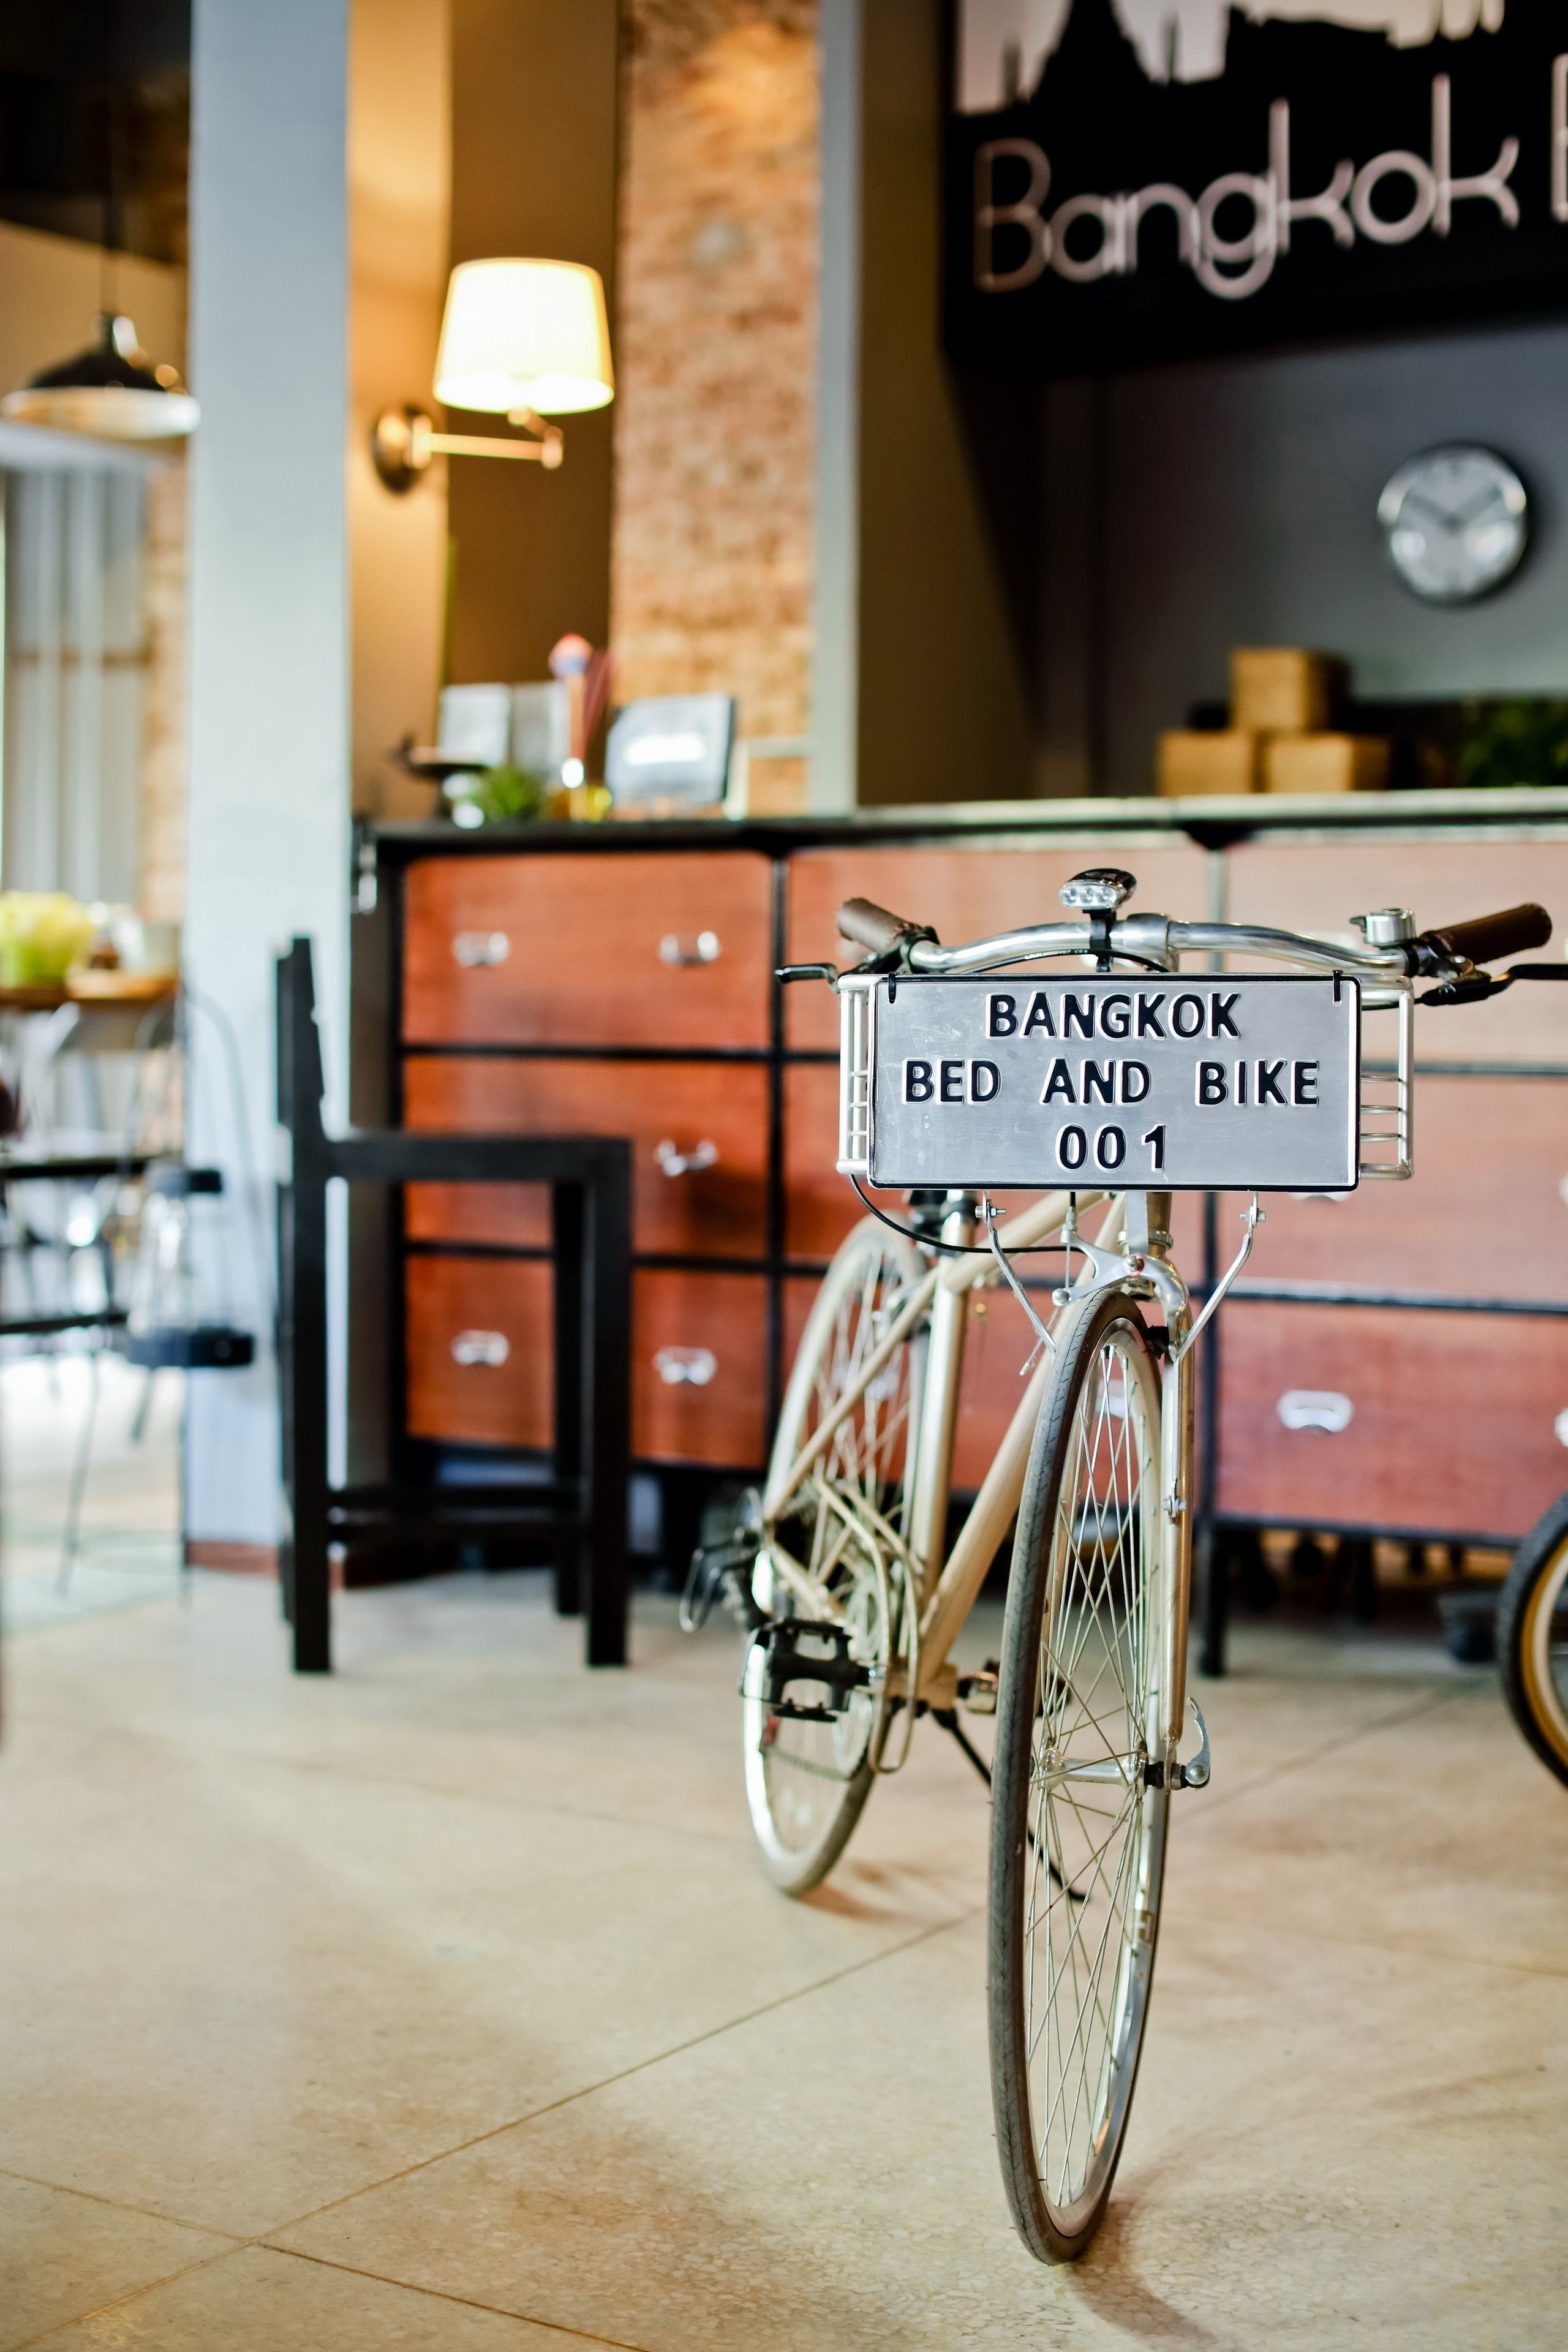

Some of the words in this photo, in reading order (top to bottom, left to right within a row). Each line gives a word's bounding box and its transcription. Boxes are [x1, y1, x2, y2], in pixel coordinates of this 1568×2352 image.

[974, 74, 1520, 299] Bangkok
[988, 992, 1241, 1039] BANGKOK
[903, 1060, 1001, 1104] BED
[1041, 1058, 1150, 1105] AND
[1198, 1060, 1320, 1106] BIKE
[1058, 1124, 1166, 1170] 001
